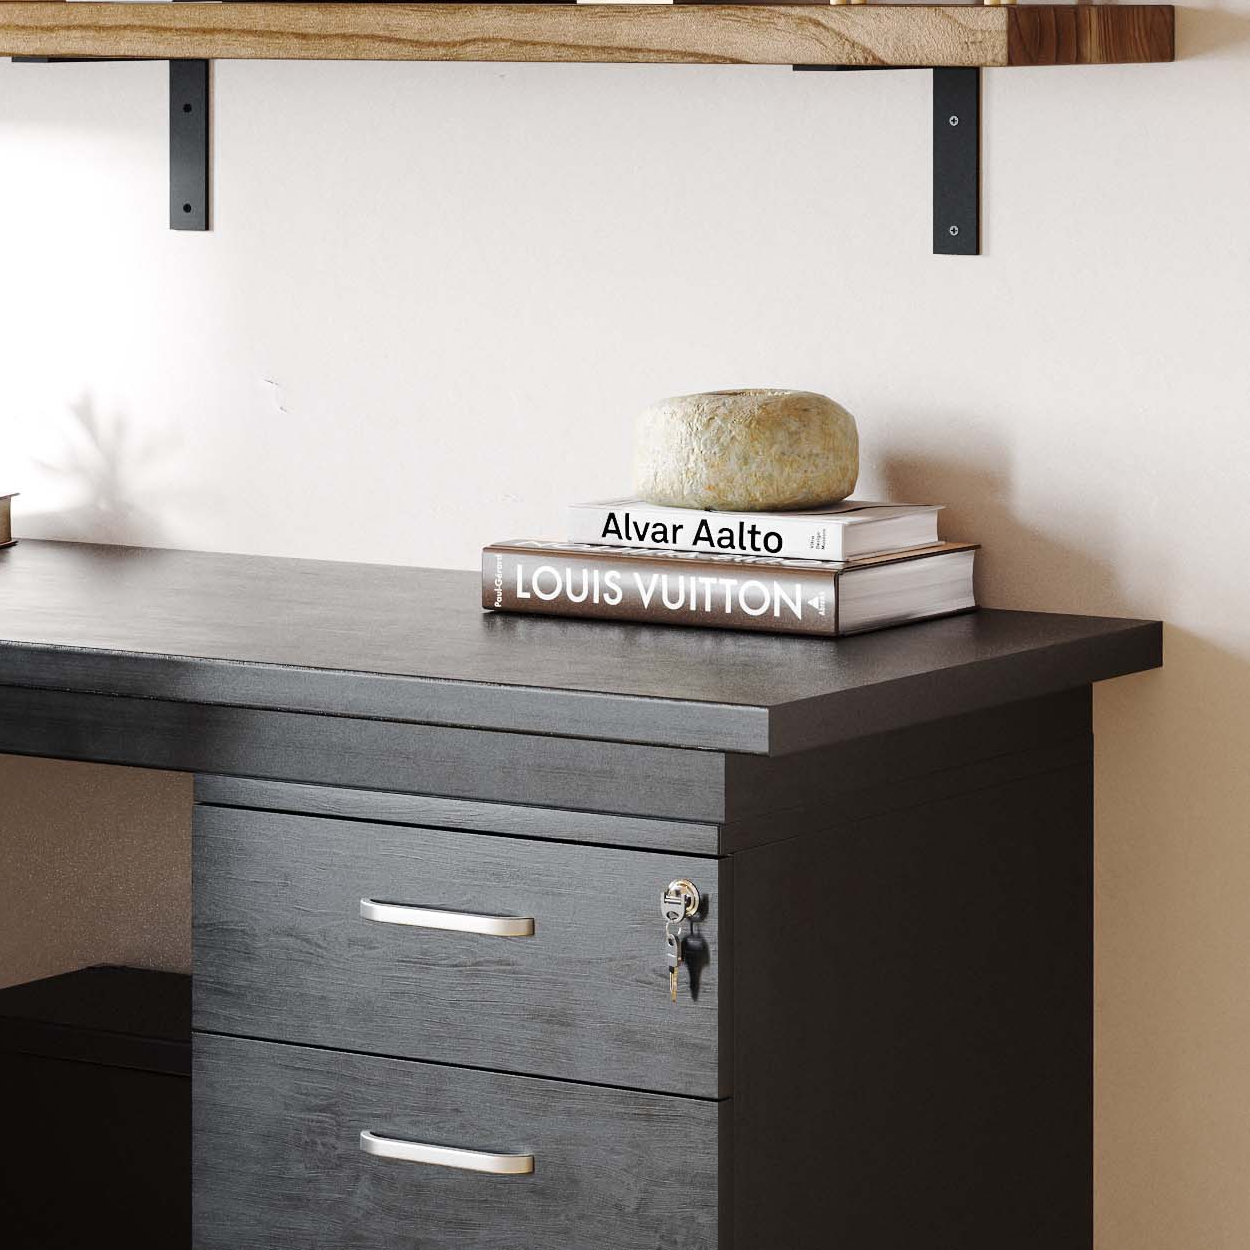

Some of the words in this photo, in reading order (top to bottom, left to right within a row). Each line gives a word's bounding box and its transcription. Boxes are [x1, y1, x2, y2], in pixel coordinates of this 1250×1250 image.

[601, 511, 684, 545] Alvar
[692, 518, 784, 554] Aalto
[516, 563, 624, 606] LOUIS
[633, 572, 803, 621] VUITTON
